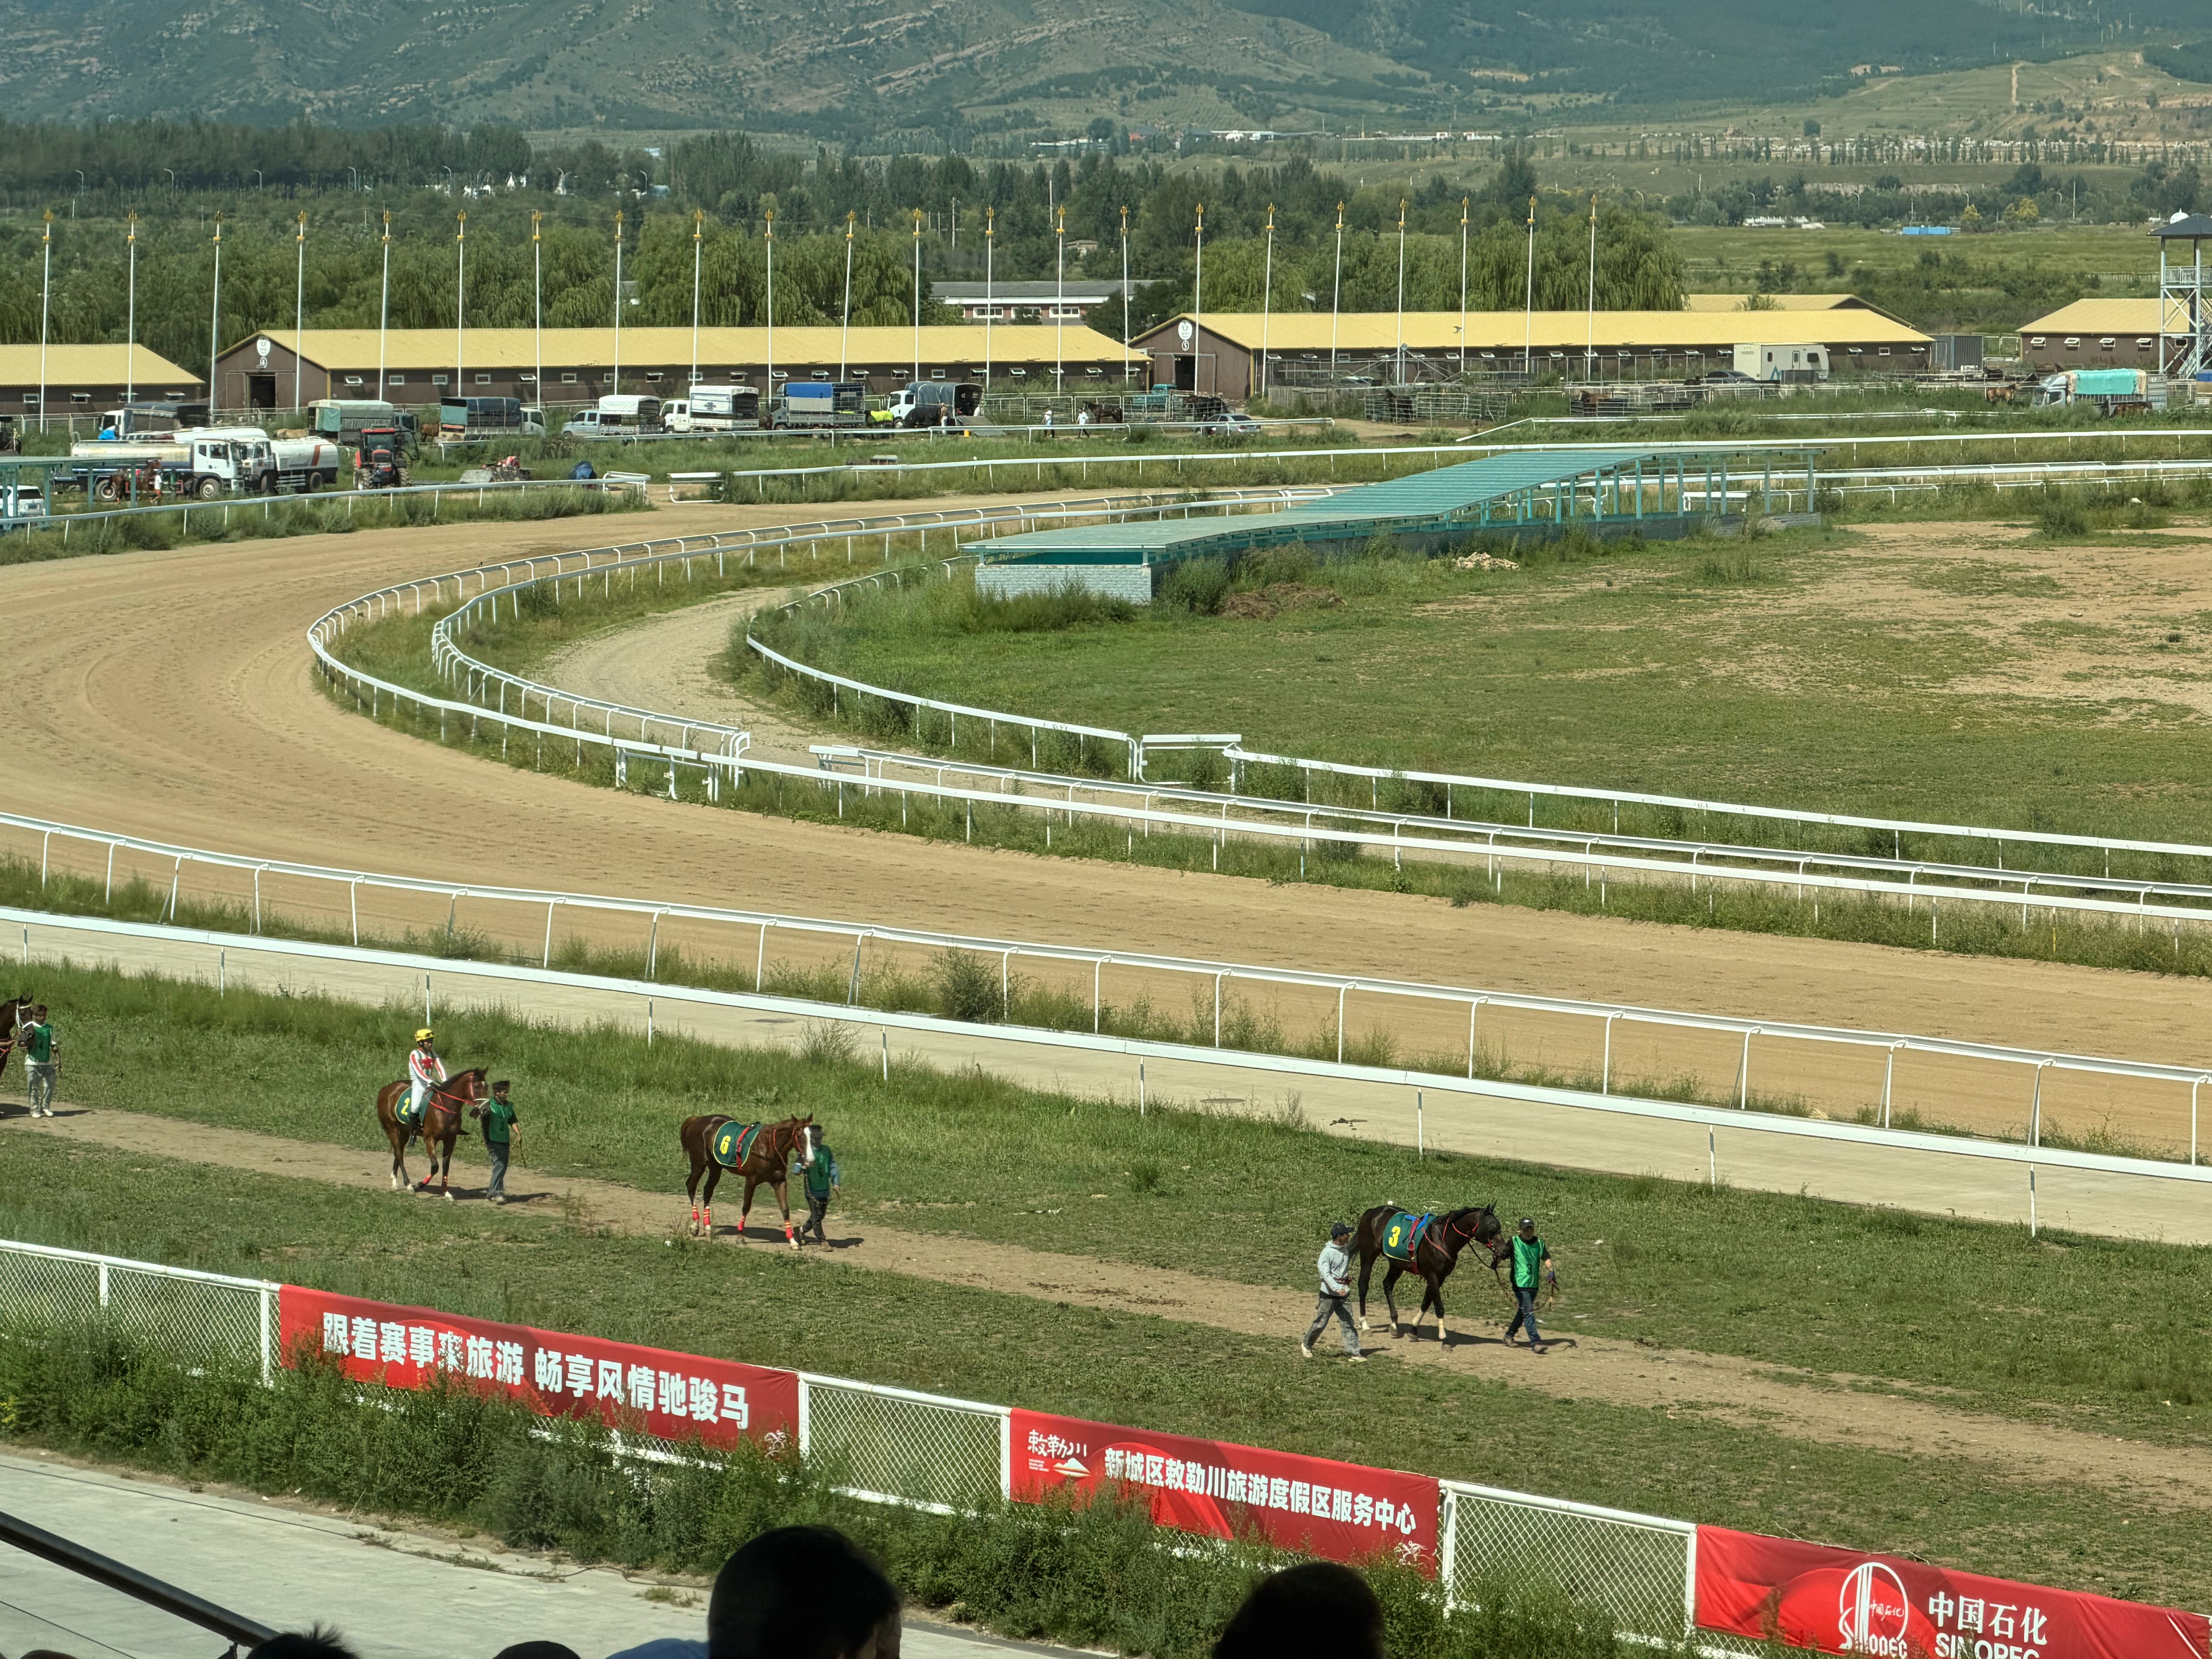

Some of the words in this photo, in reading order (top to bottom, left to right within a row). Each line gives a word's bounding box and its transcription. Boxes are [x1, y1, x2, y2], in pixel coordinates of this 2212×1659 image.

[401, 1097, 410, 1115] 2
[720, 1135, 731, 1154] 6
[1388, 1226, 1401, 1247] 3
[1527, 1263, 1532, 1275] 3
[323, 1312, 524, 1385] 跟着赛事来旅游
[535, 1347, 749, 1429] 畅享风情驰骏马
[1027, 1429, 1087, 1458] 敕勒川
[1104, 1448, 1416, 1535] 新城区敕勒川旅游度假区服务中心
[1870, 1599, 1904, 1621] 中国石化
[1929, 1591, 2048, 1645] 中国石化
